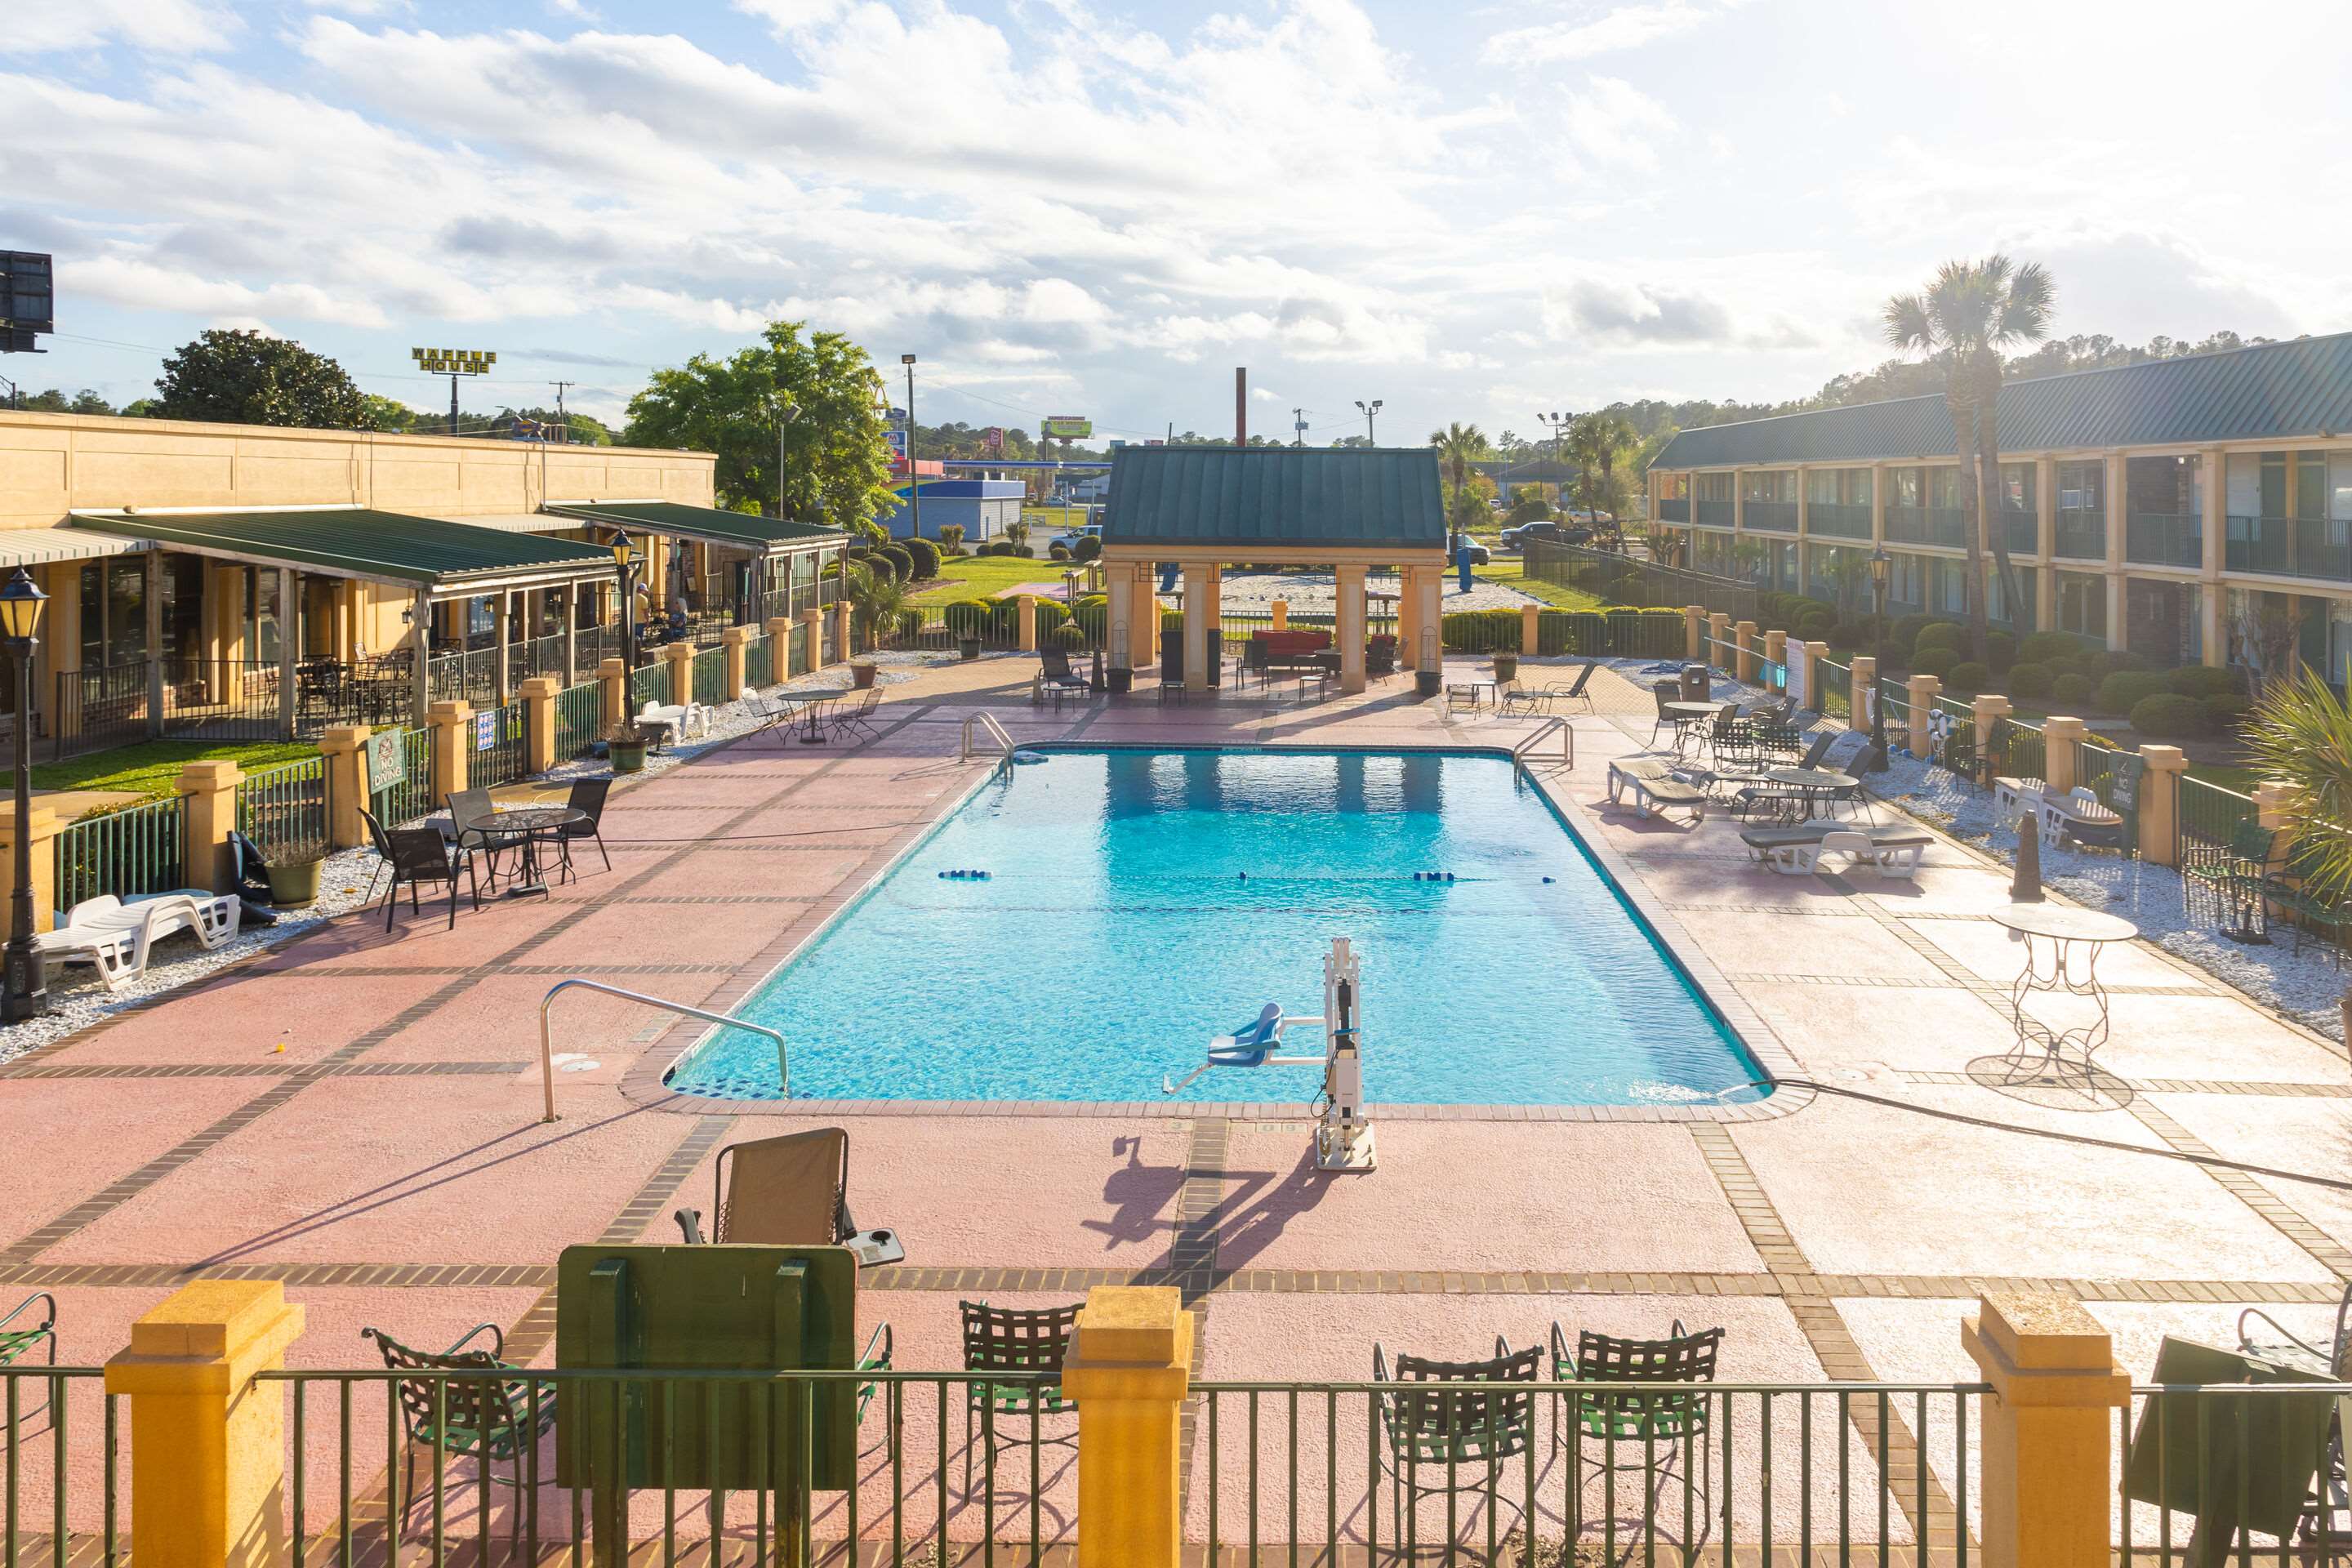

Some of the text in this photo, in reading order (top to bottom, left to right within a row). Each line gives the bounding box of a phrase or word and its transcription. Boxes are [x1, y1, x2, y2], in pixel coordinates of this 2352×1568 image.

[412, 348, 496, 362] WAFFLE
[421, 361, 488, 373] HOUSE
[381, 757, 394, 770] NO
[374, 767, 402, 786] DIVING
[2118, 777, 2128, 789] NO
[2113, 788, 2132, 804] DIVING
